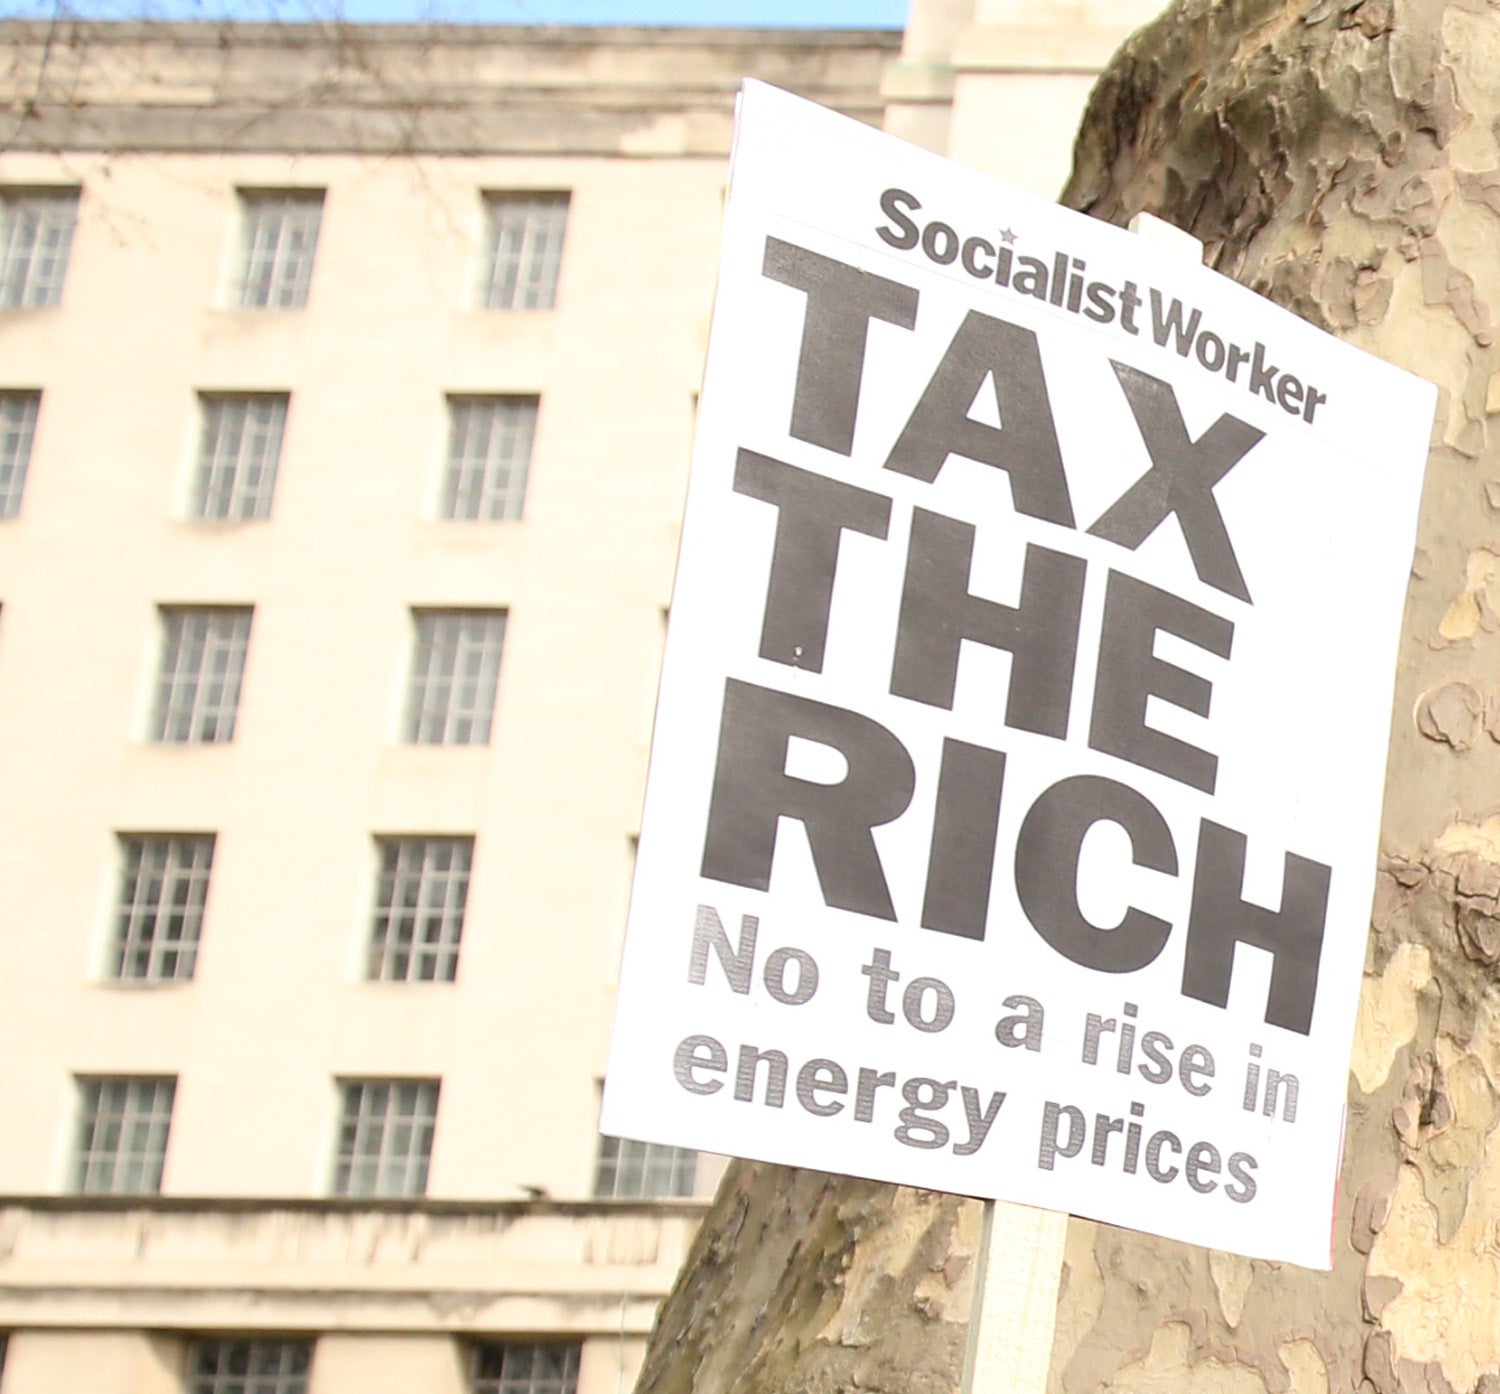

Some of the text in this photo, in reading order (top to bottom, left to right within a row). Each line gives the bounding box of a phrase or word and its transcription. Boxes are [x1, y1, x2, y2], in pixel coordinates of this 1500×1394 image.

[761, 234, 1267, 606] TAX
[732, 446, 1236, 796] THE
[688, 904, 1300, 1123] No to a rise in
[700, 676, 1332, 1036] RICH
[673, 1035, 1259, 1203] energy prices
